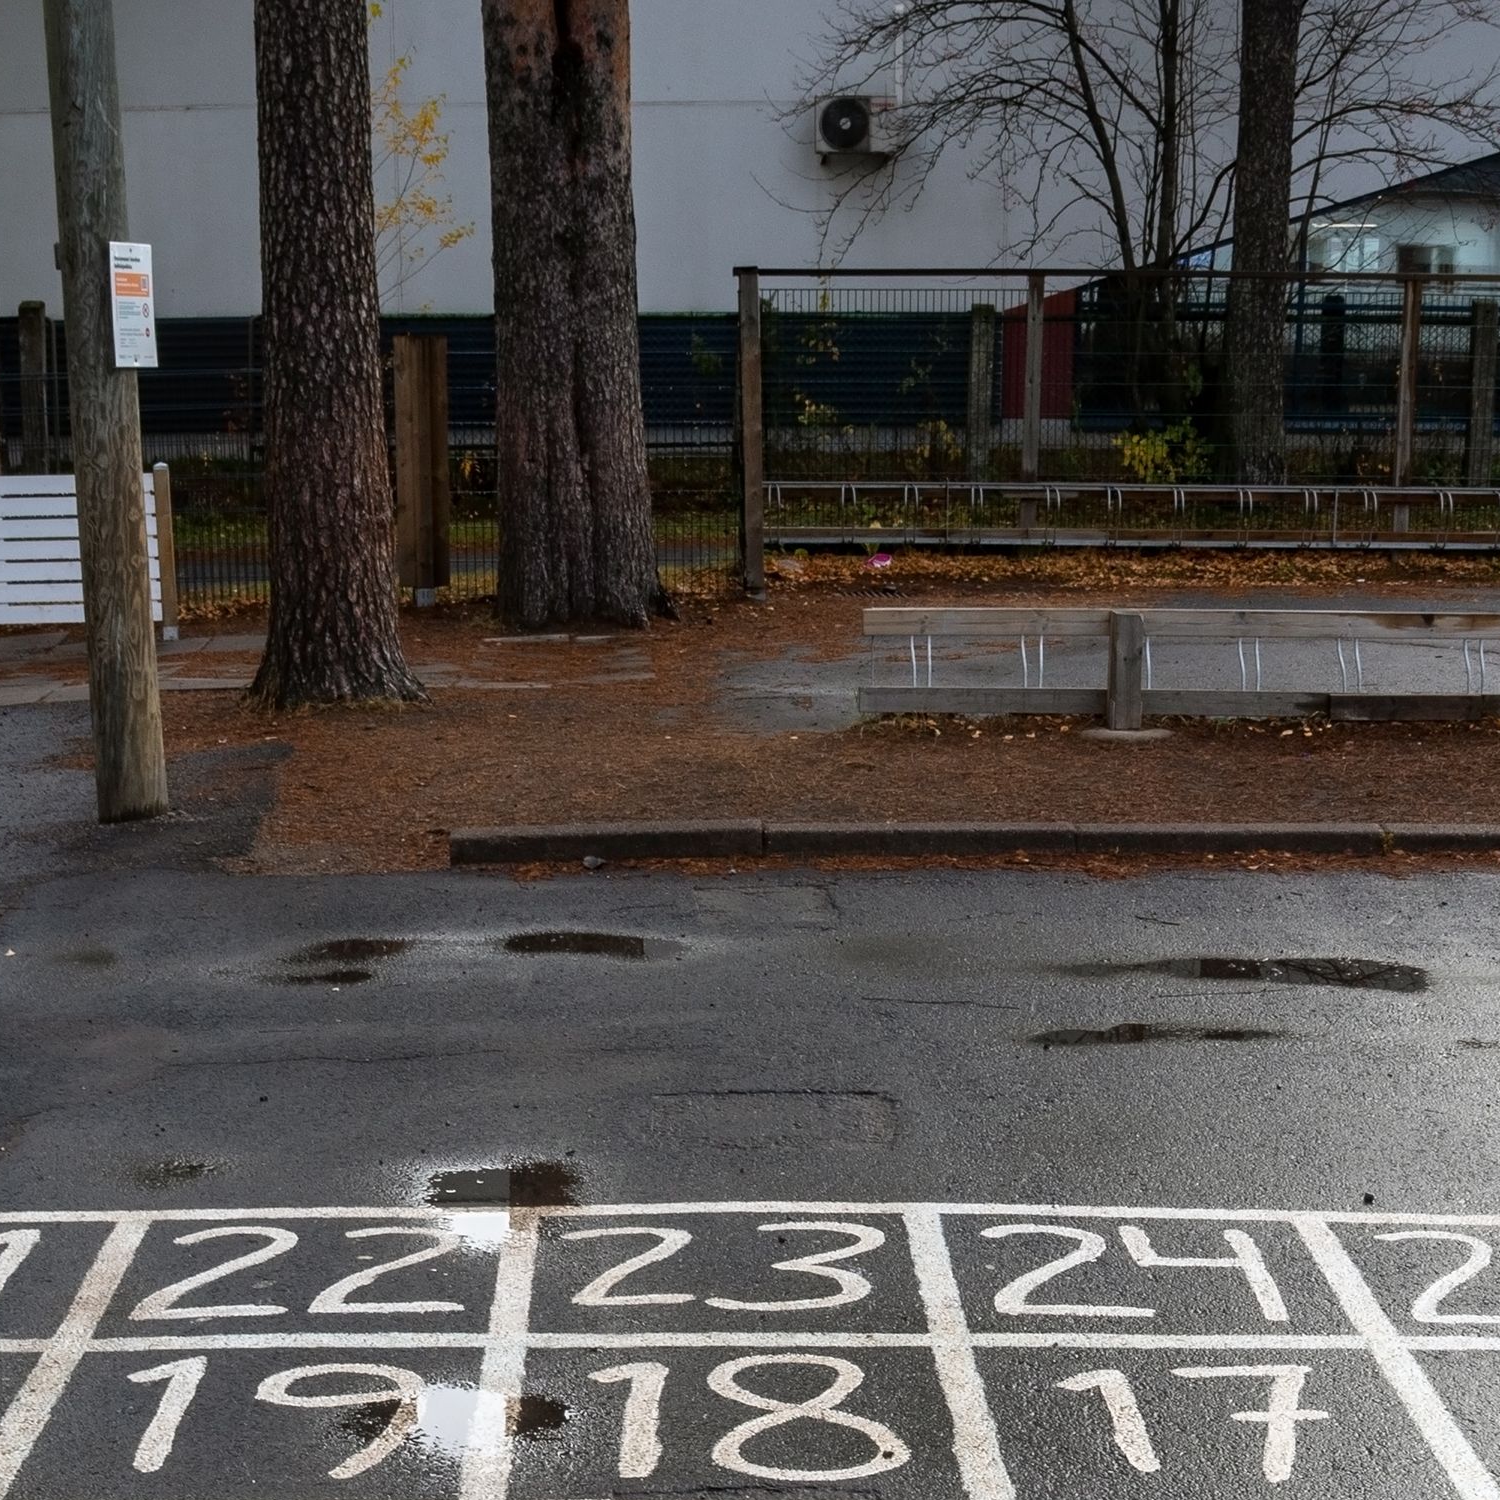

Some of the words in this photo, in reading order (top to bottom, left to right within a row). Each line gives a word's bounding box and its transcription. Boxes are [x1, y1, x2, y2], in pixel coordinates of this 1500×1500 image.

[130, 1226, 465, 1320] 22
[562, 1222, 886, 1311] 23
[980, 1225, 1291, 1320] 24
[127, 1355, 427, 1478] 19
[588, 1354, 911, 1481] 18
[1056, 1365, 1330, 1484] 17
